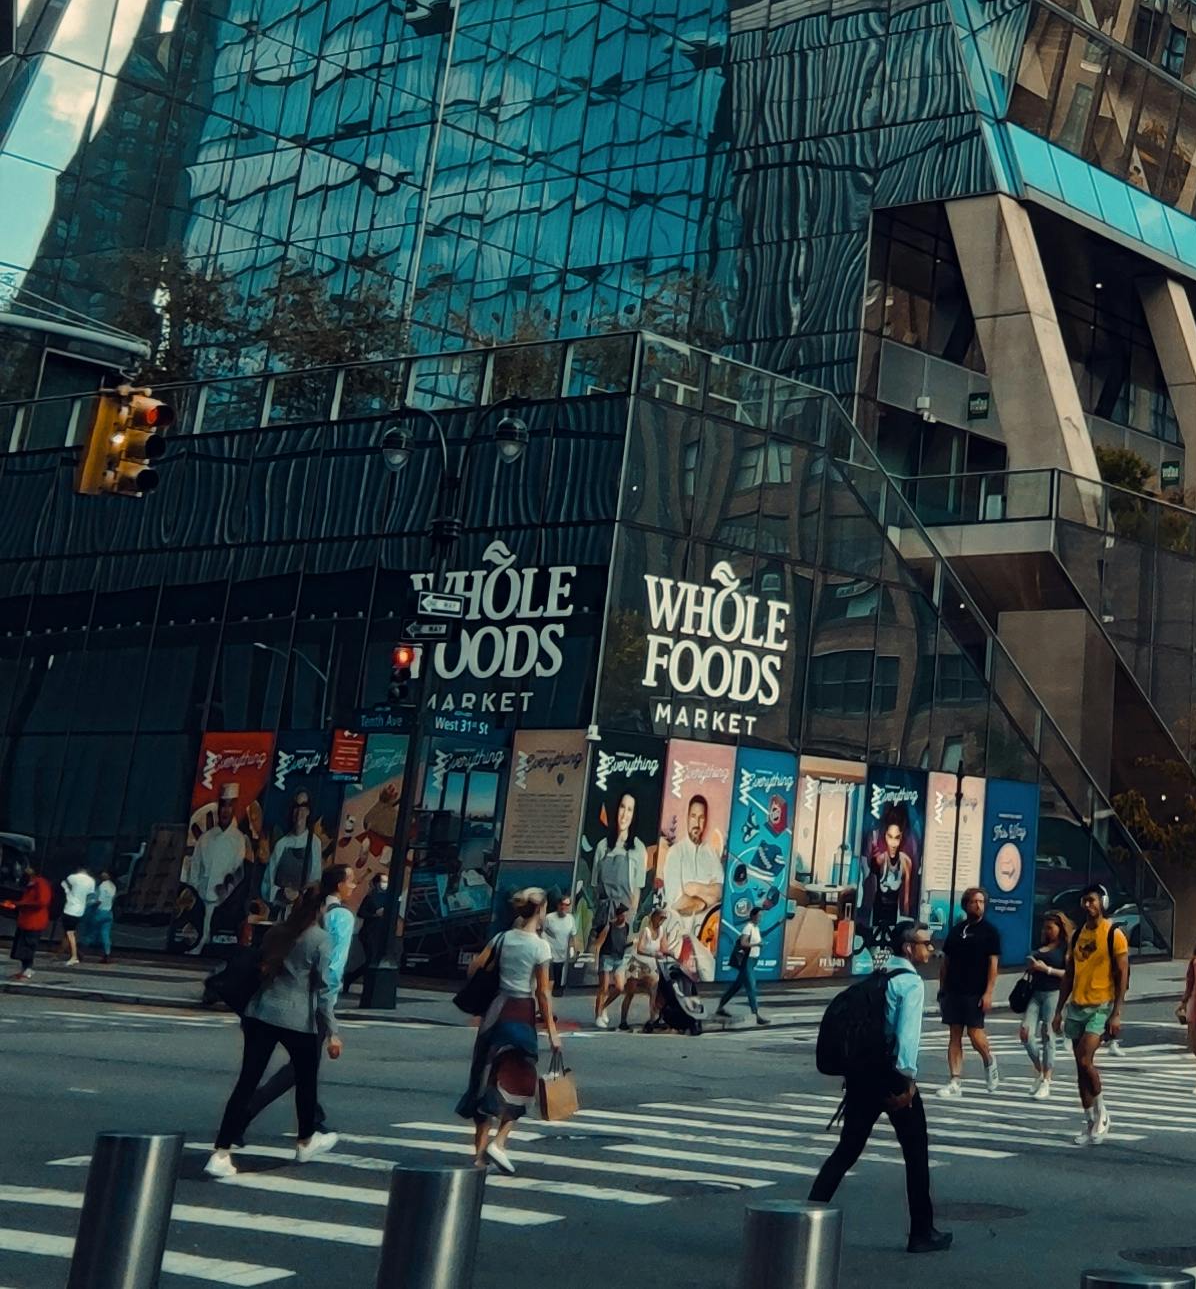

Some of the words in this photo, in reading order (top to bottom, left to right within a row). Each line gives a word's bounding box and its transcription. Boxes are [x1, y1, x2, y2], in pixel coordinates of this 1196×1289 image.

[644, 566, 790, 652] WHOLE
[642, 633, 782, 706] FOODS
[385, 714, 403, 727] Ave
[435, 716, 459, 731] West
[655, 702, 757, 736] MARKET
[445, 747, 504, 773] Everything
[607, 754, 660, 778] Everything
[749, 772, 795, 793] Everything
[881, 786, 919, 807] Everything
